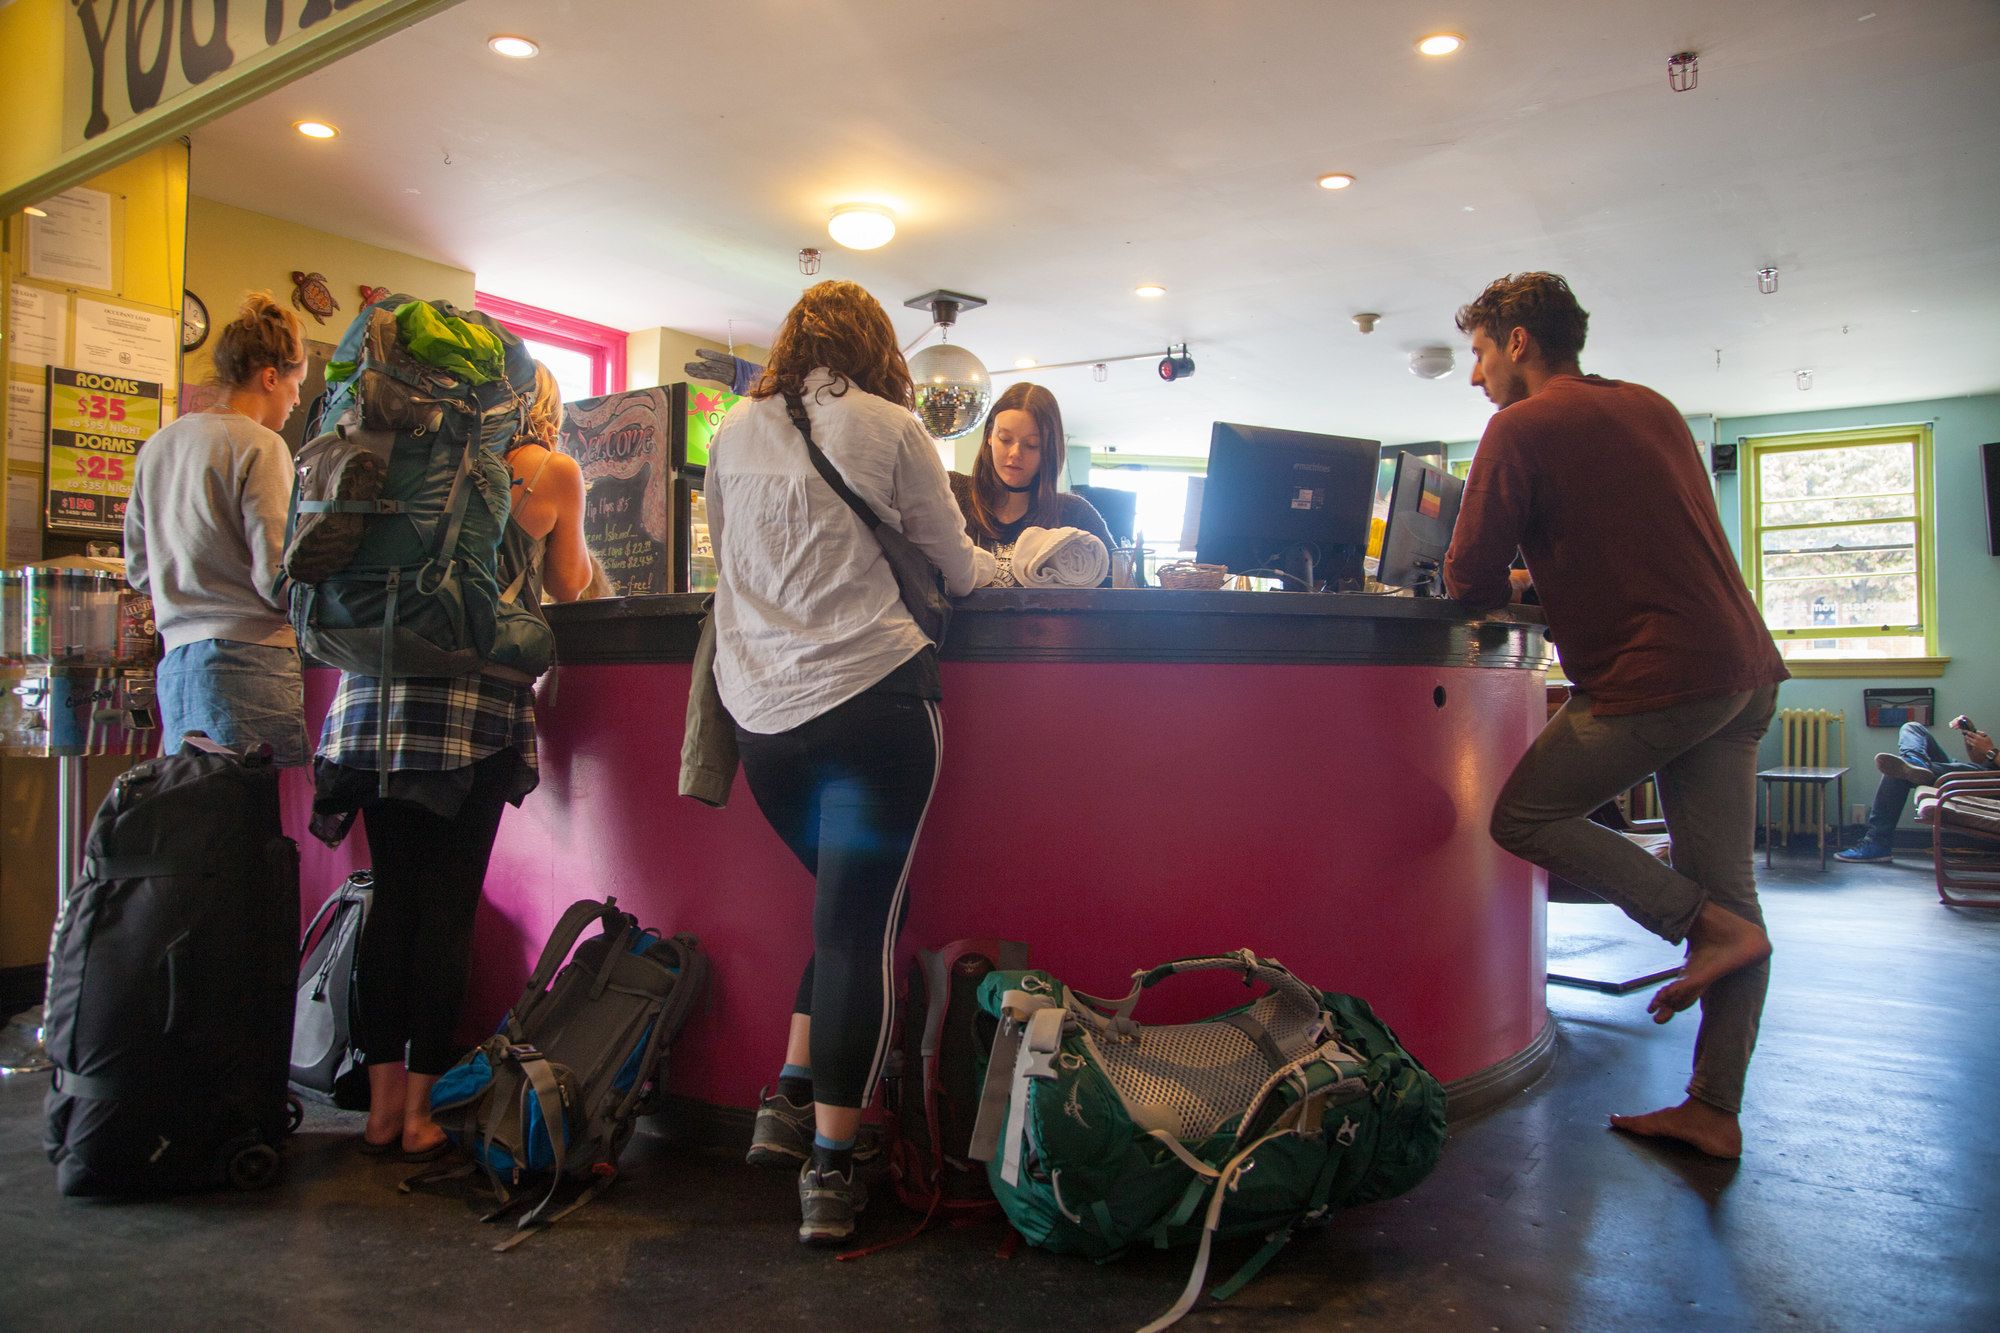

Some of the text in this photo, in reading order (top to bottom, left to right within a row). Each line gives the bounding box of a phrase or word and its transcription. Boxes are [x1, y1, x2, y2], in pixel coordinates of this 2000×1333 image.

[104, 308, 134, 319] OCCUPANT
[76, 373, 139, 394] ROOMS
[78, 395, 127, 421] $35
[109, 423, 141, 435] NIGHT
[75, 434, 136, 454] DORMS
[75, 456, 124, 481] $25
[108, 482, 133, 494] NIGH
